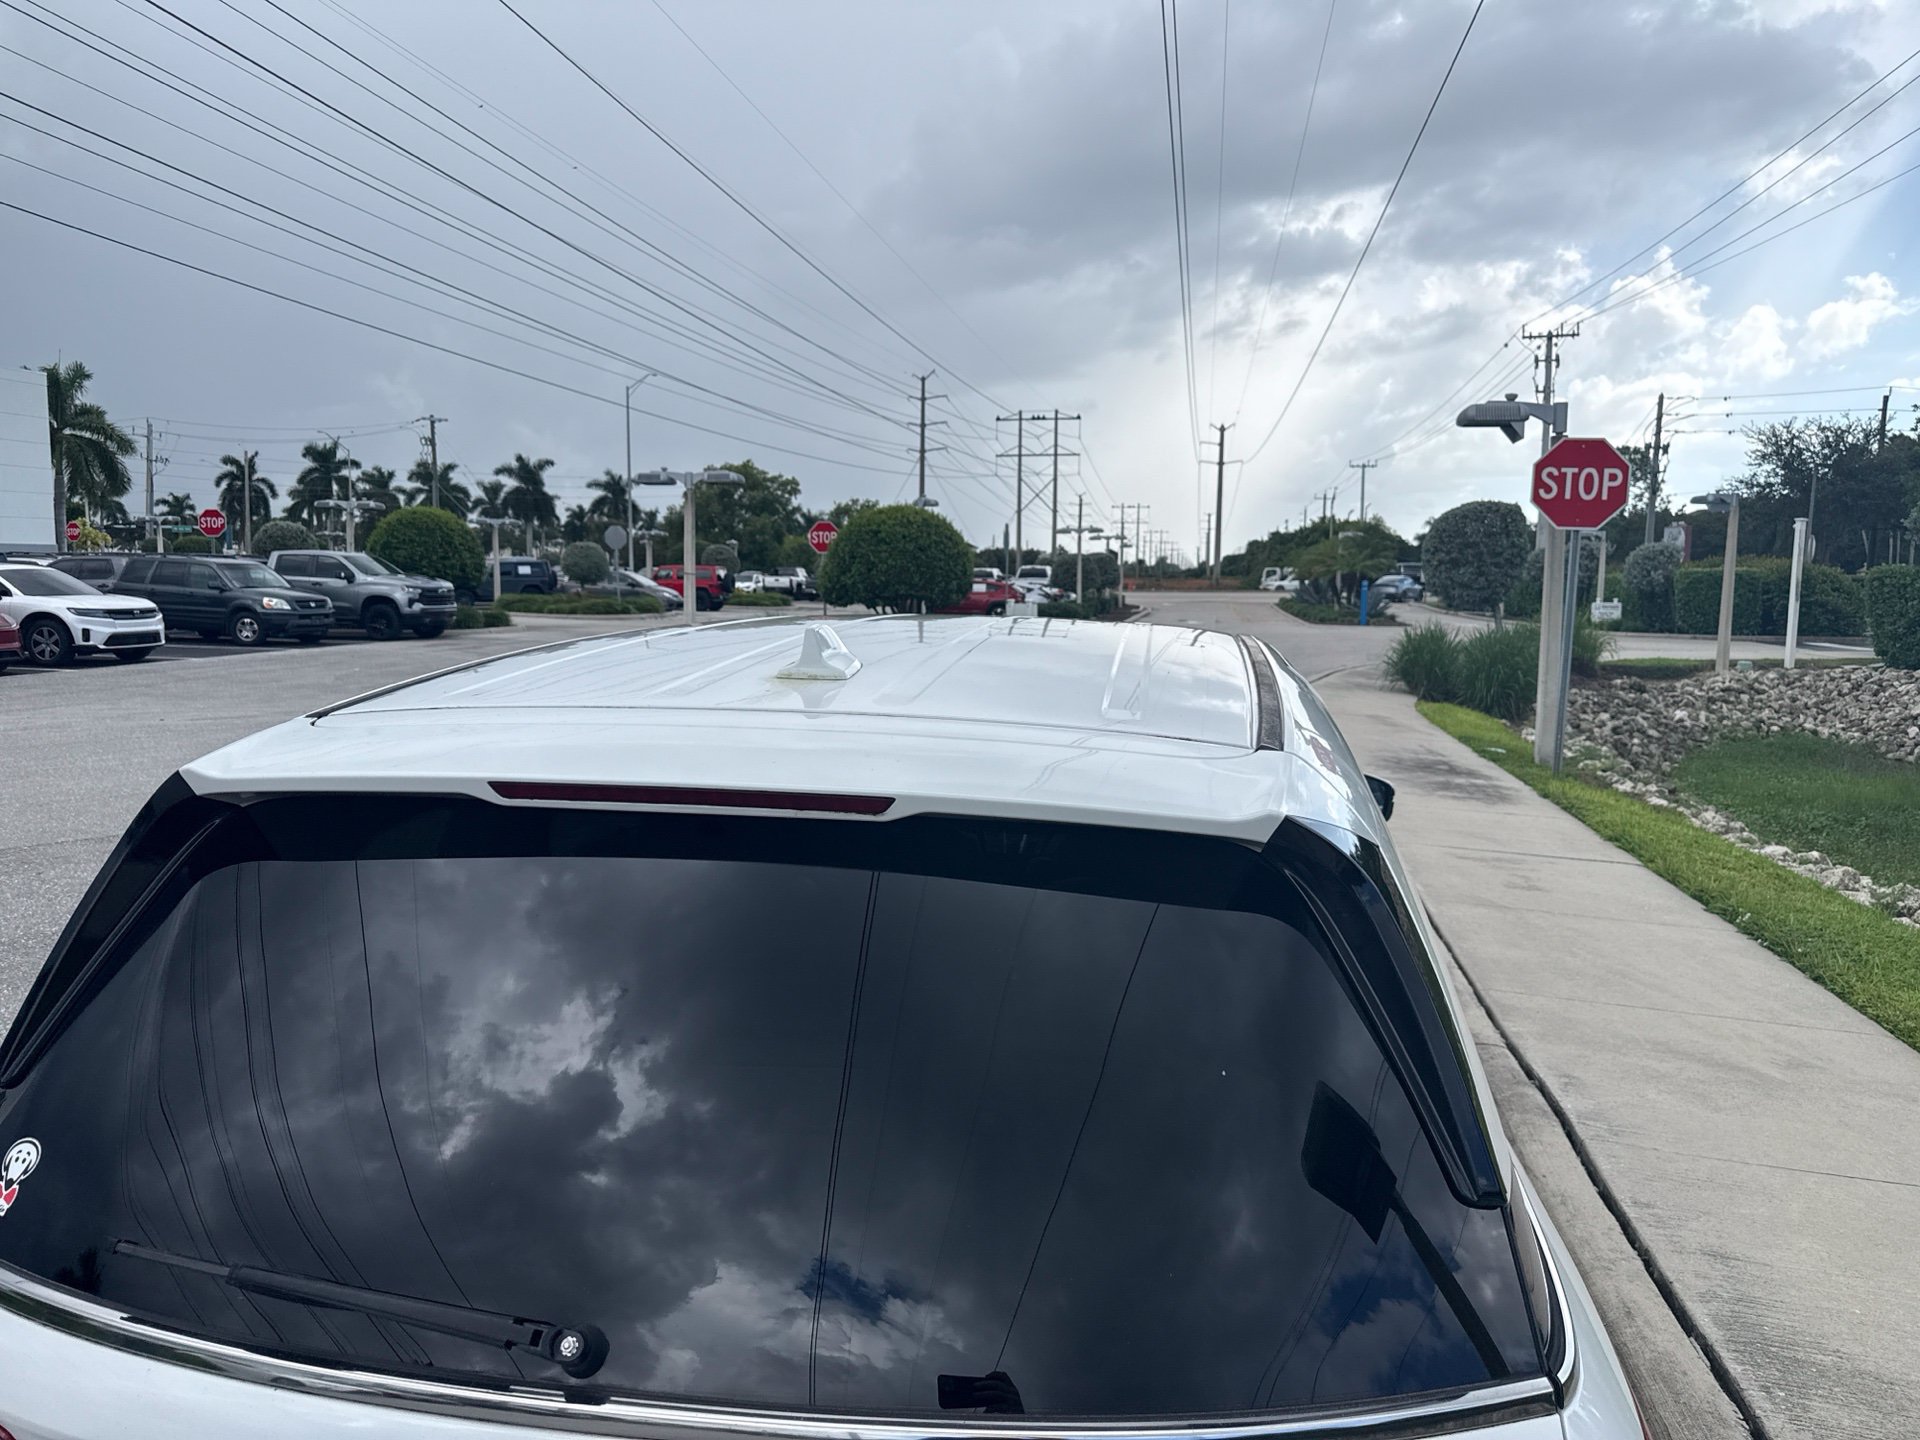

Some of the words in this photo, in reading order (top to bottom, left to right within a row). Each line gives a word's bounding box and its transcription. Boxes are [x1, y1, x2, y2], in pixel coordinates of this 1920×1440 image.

[1538, 466, 1624, 501] STOP
[200, 516, 225, 529] STOP
[66, 528, 81, 536] STOP
[811, 531, 838, 544] STOP
